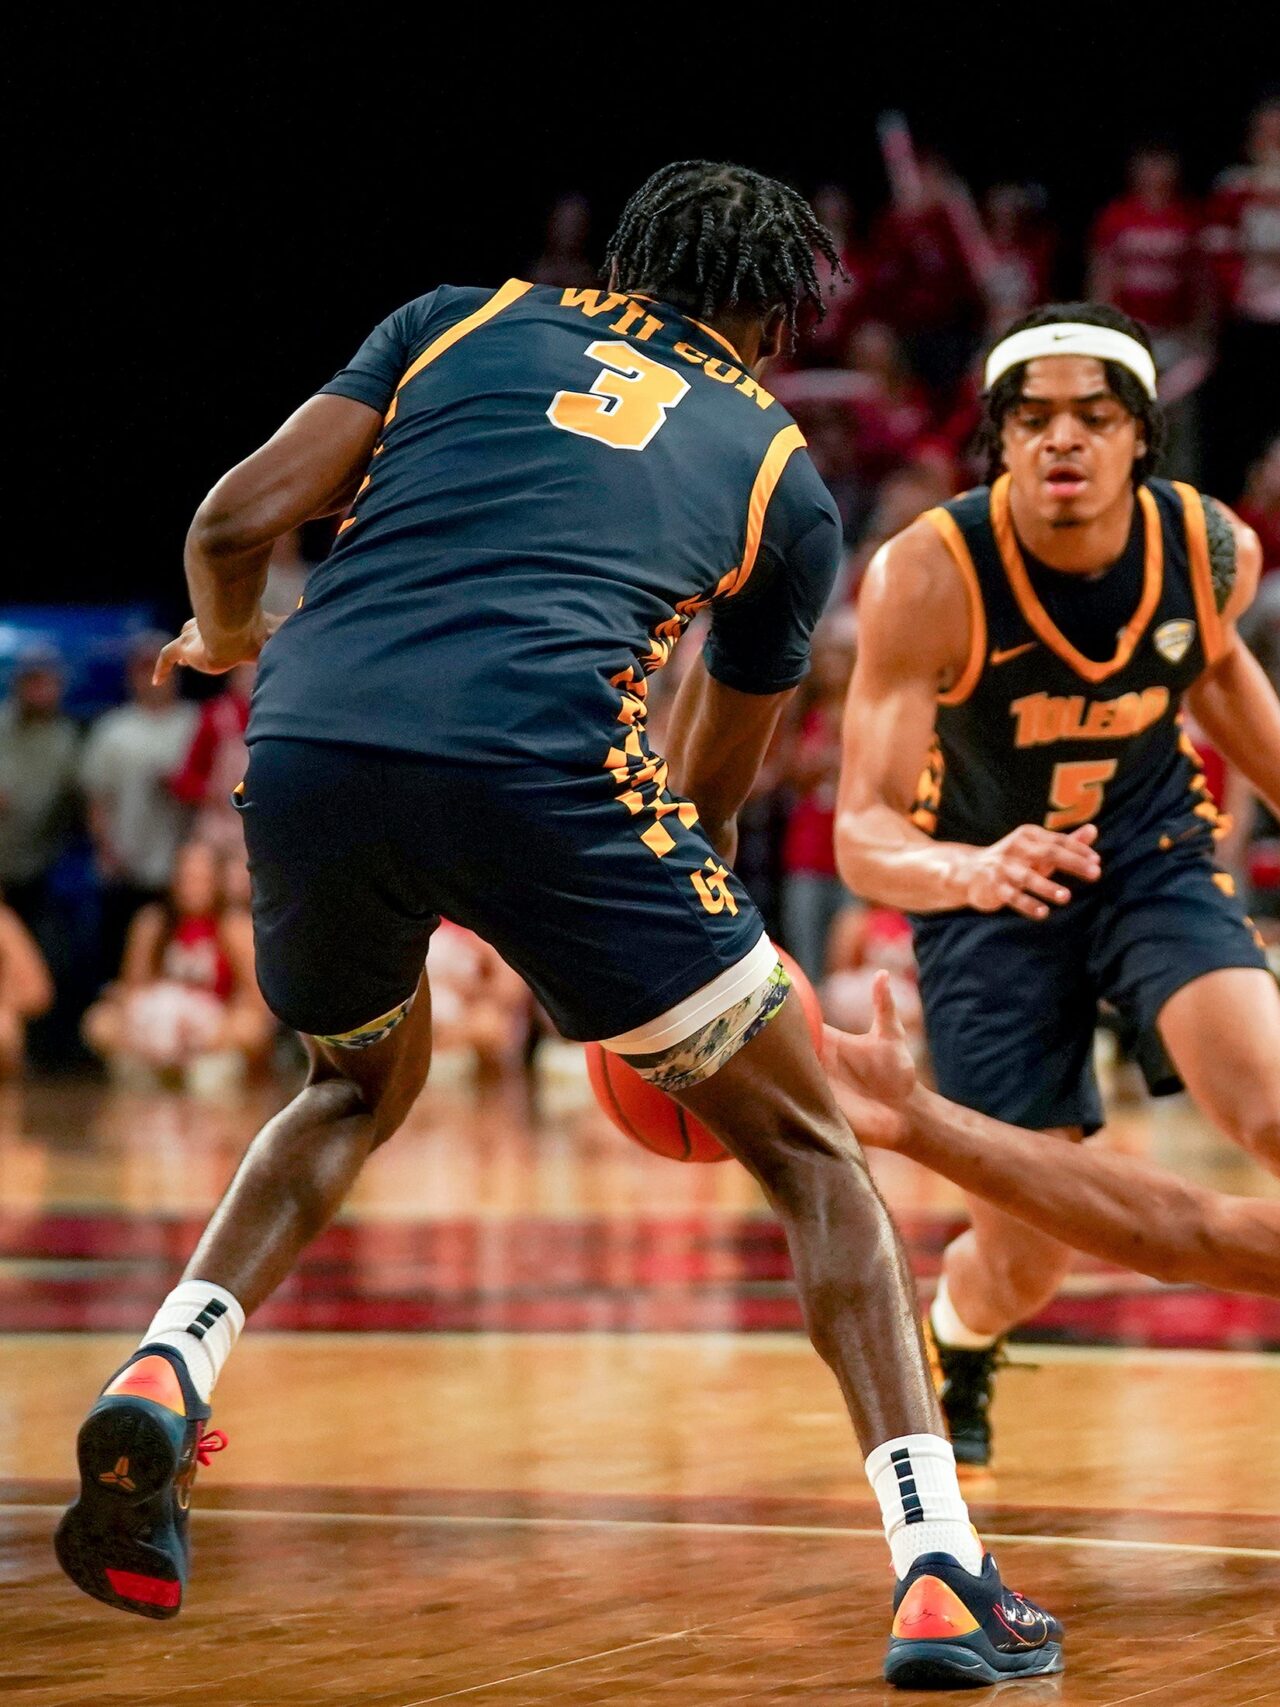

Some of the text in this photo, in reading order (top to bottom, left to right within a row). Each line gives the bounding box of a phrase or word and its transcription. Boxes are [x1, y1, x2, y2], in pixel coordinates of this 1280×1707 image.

[545, 340, 692, 451] 3
[1010, 686, 1168, 748] TOLEDO
[1044, 758, 1118, 831] 5
